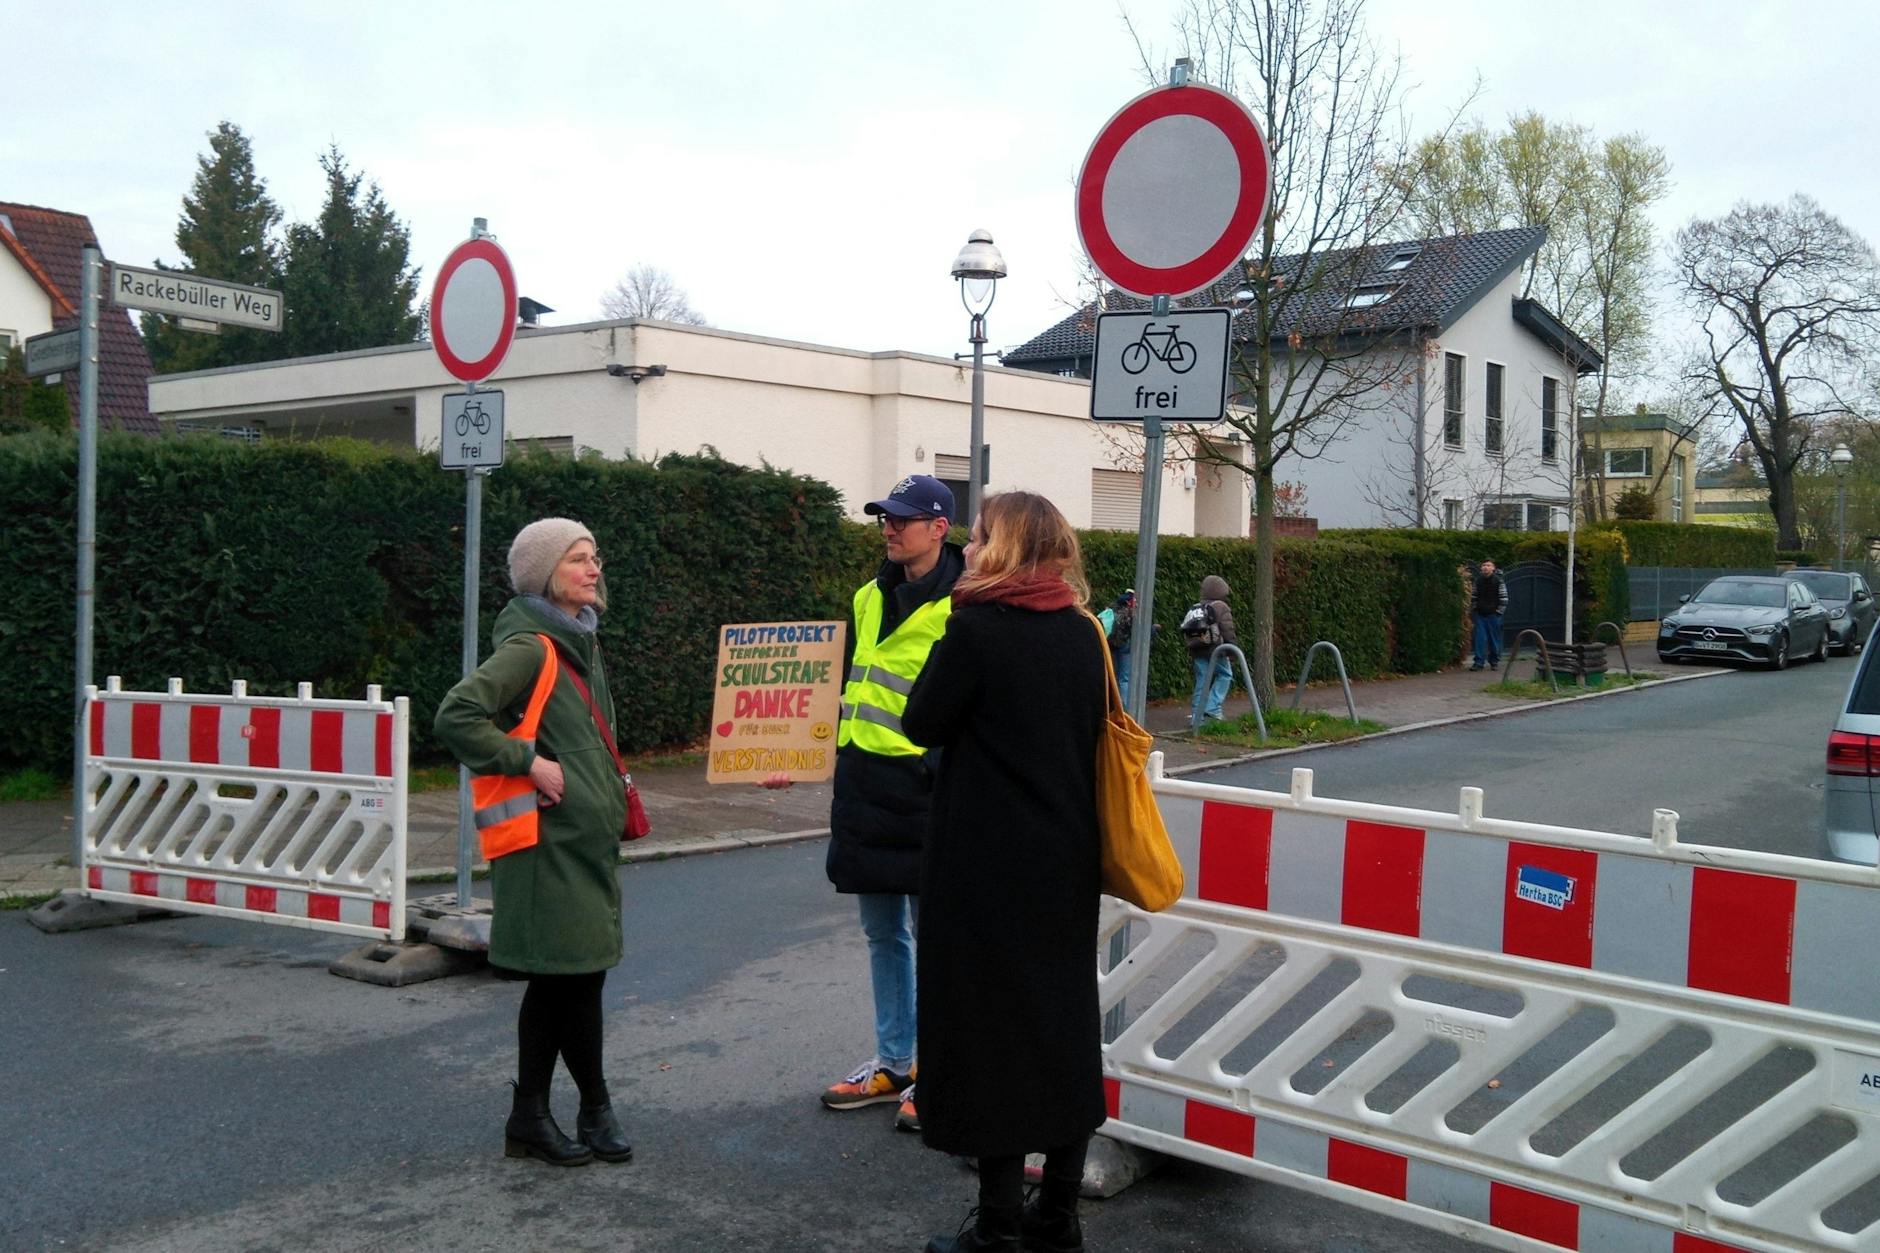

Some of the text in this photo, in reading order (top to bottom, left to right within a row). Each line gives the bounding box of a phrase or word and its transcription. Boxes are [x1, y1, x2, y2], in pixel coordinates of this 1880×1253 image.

[121, 273, 271, 321] Rackebüller Weg
[1135, 385, 1178, 409] frei
[461, 442, 482, 459] frei
[725, 625, 836, 646] PILOTPROJEKT
[729, 645, 799, 660] TEMPORÄRE
[734, 688, 813, 718] DANKE
[713, 747, 826, 773] VERSTÄNDNIS
[1519, 884, 1547, 904] Hertha
[1548, 891, 1563, 907] BSC
